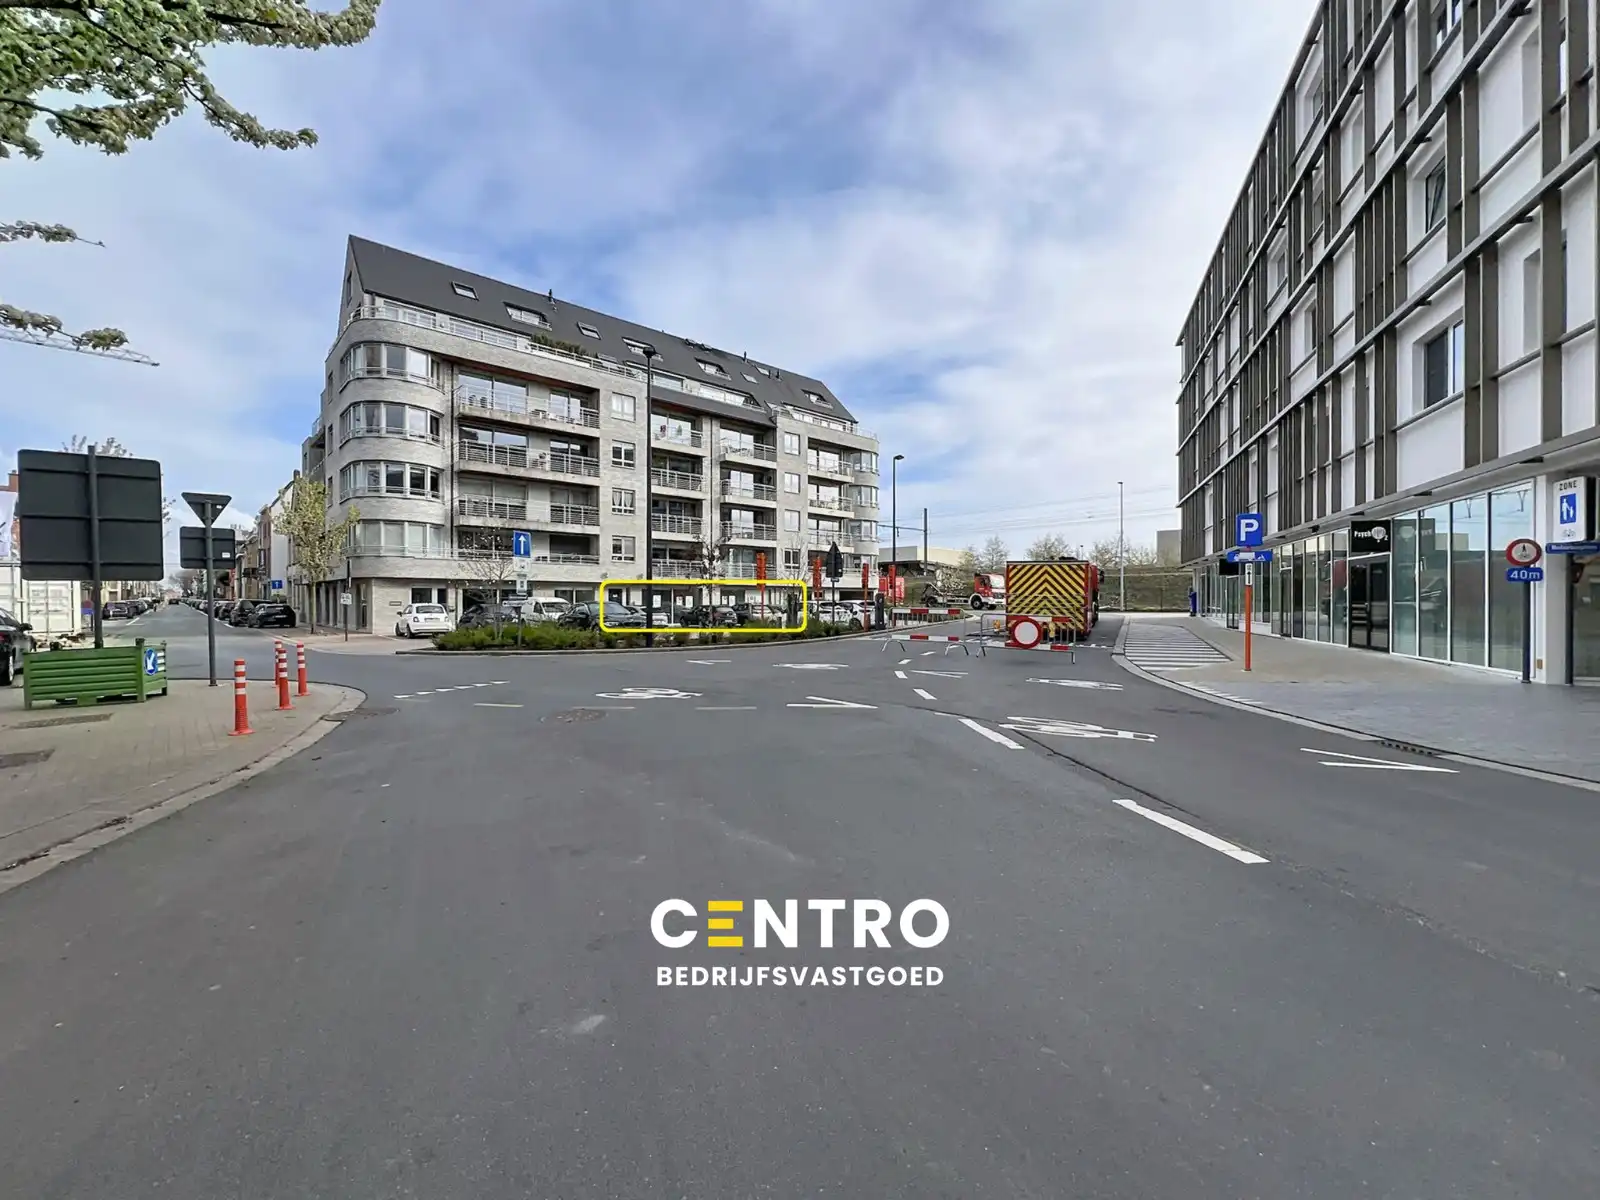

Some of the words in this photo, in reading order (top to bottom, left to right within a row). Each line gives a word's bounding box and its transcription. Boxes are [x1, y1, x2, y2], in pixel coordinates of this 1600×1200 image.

[1559, 480, 1577, 491] ZONE
[1240, 518, 1259, 542] P
[1510, 569, 1540, 580] 40m
